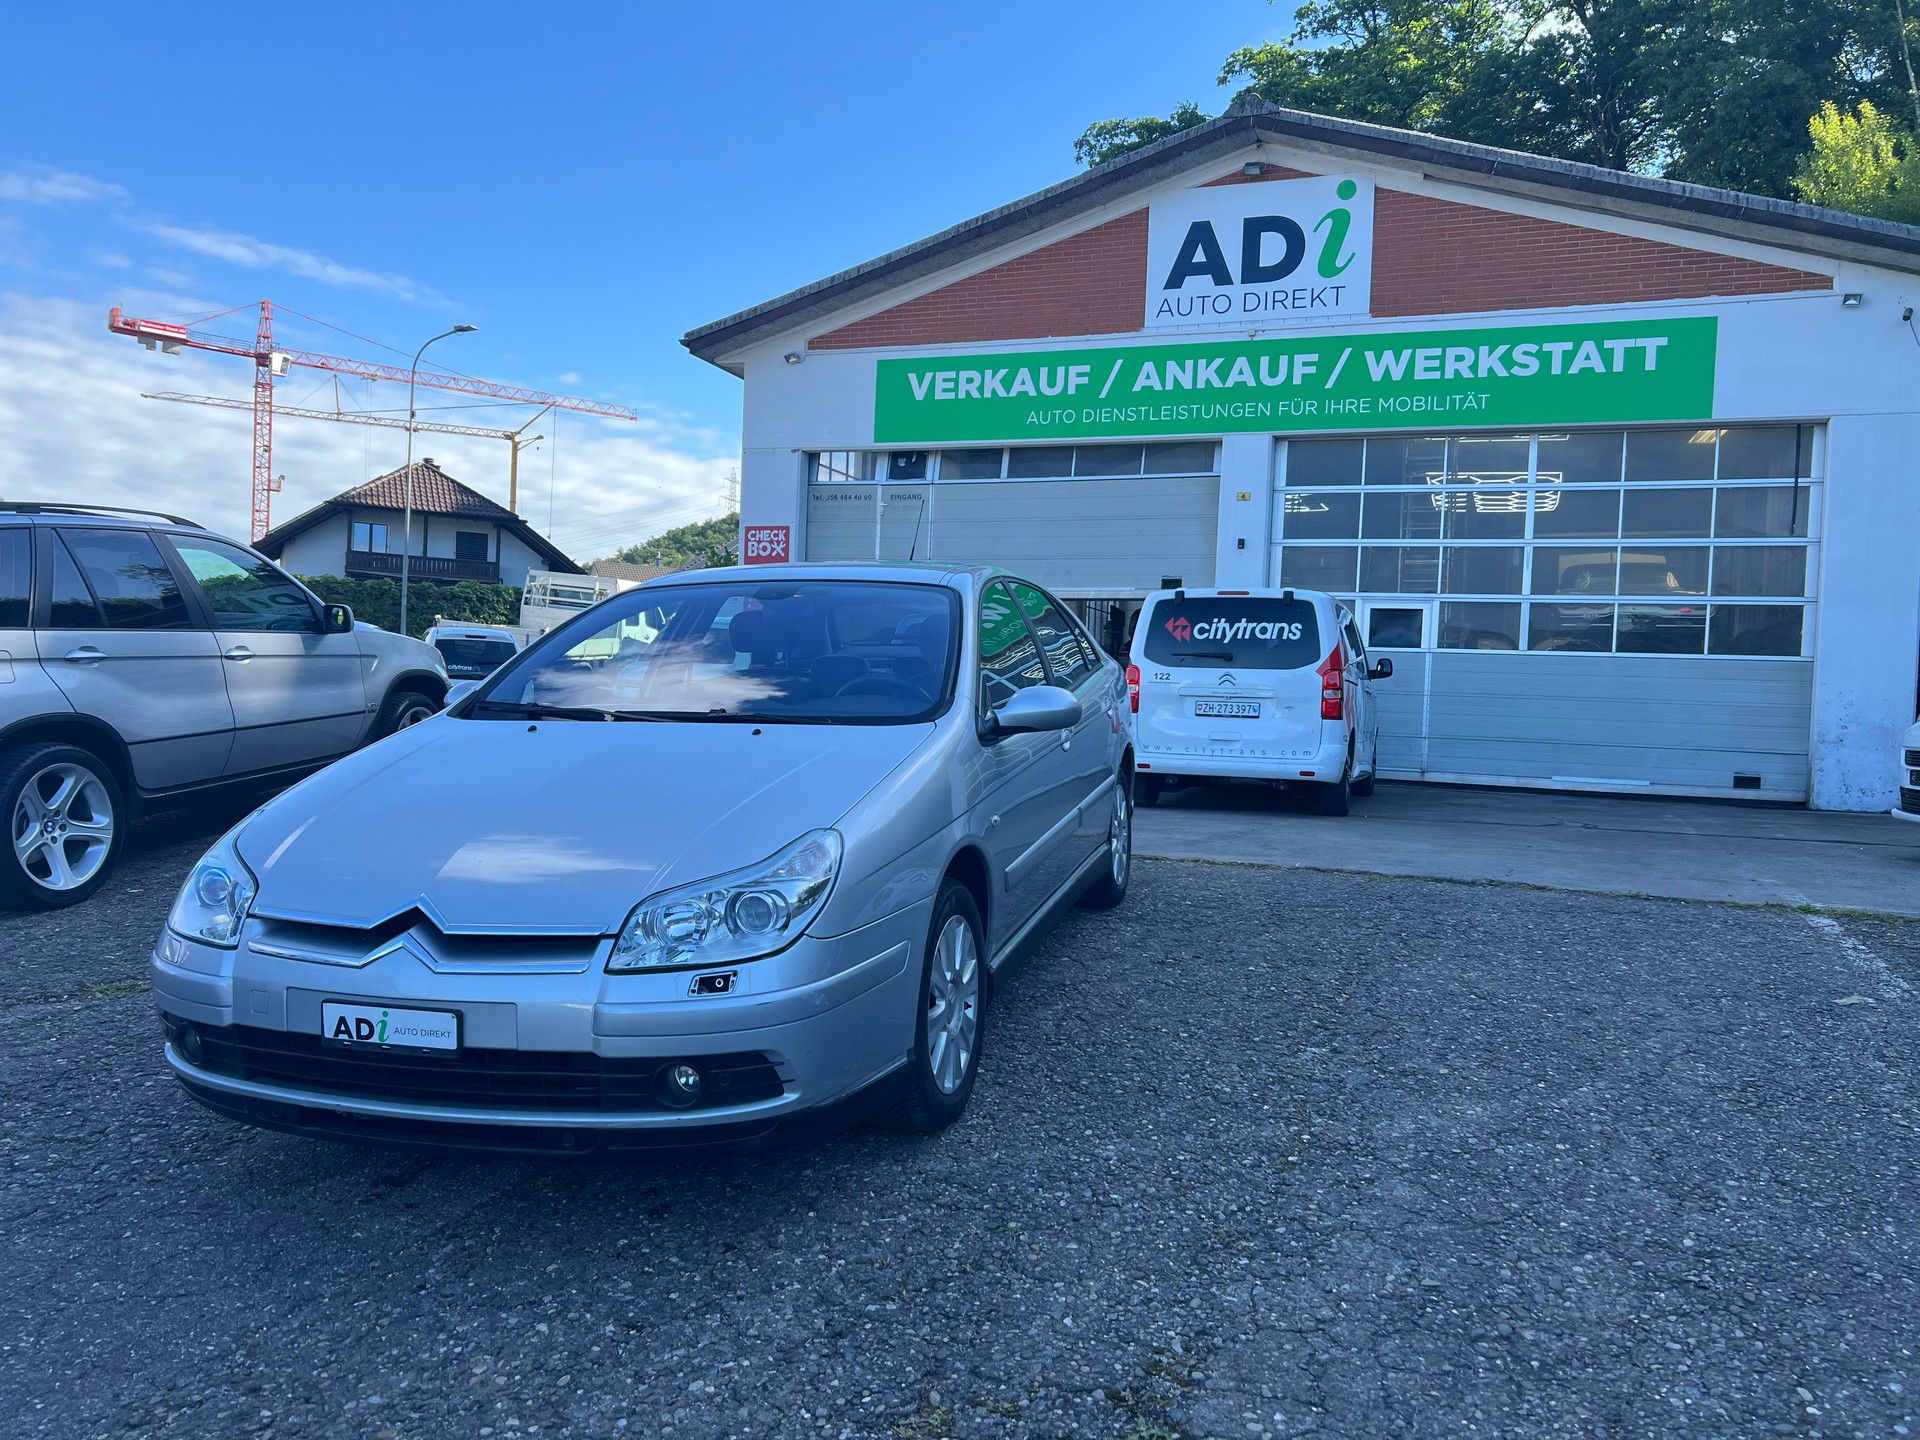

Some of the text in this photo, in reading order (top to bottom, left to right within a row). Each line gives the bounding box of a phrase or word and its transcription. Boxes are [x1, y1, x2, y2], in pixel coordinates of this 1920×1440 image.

[1156, 285, 1346, 318] AUTO DIREKT
[907, 337, 1668, 400] VERKAUF / ANKAUF / WERKSTATT
[1026, 392, 1490, 425] AUTO DIENSTLEISTUNGEN FÜR IHRE MOBILITÄT
[890, 493, 923, 501] EINGANG
[748, 530, 786, 541] CHECK
[747, 541, 786, 557] BOX
[1193, 618, 1302, 643] citytrans
[447, 664, 473, 672] citytrans
[1153, 672, 1171, 681] 122
[393, 1027, 452, 1039] AUTO DIREKT
